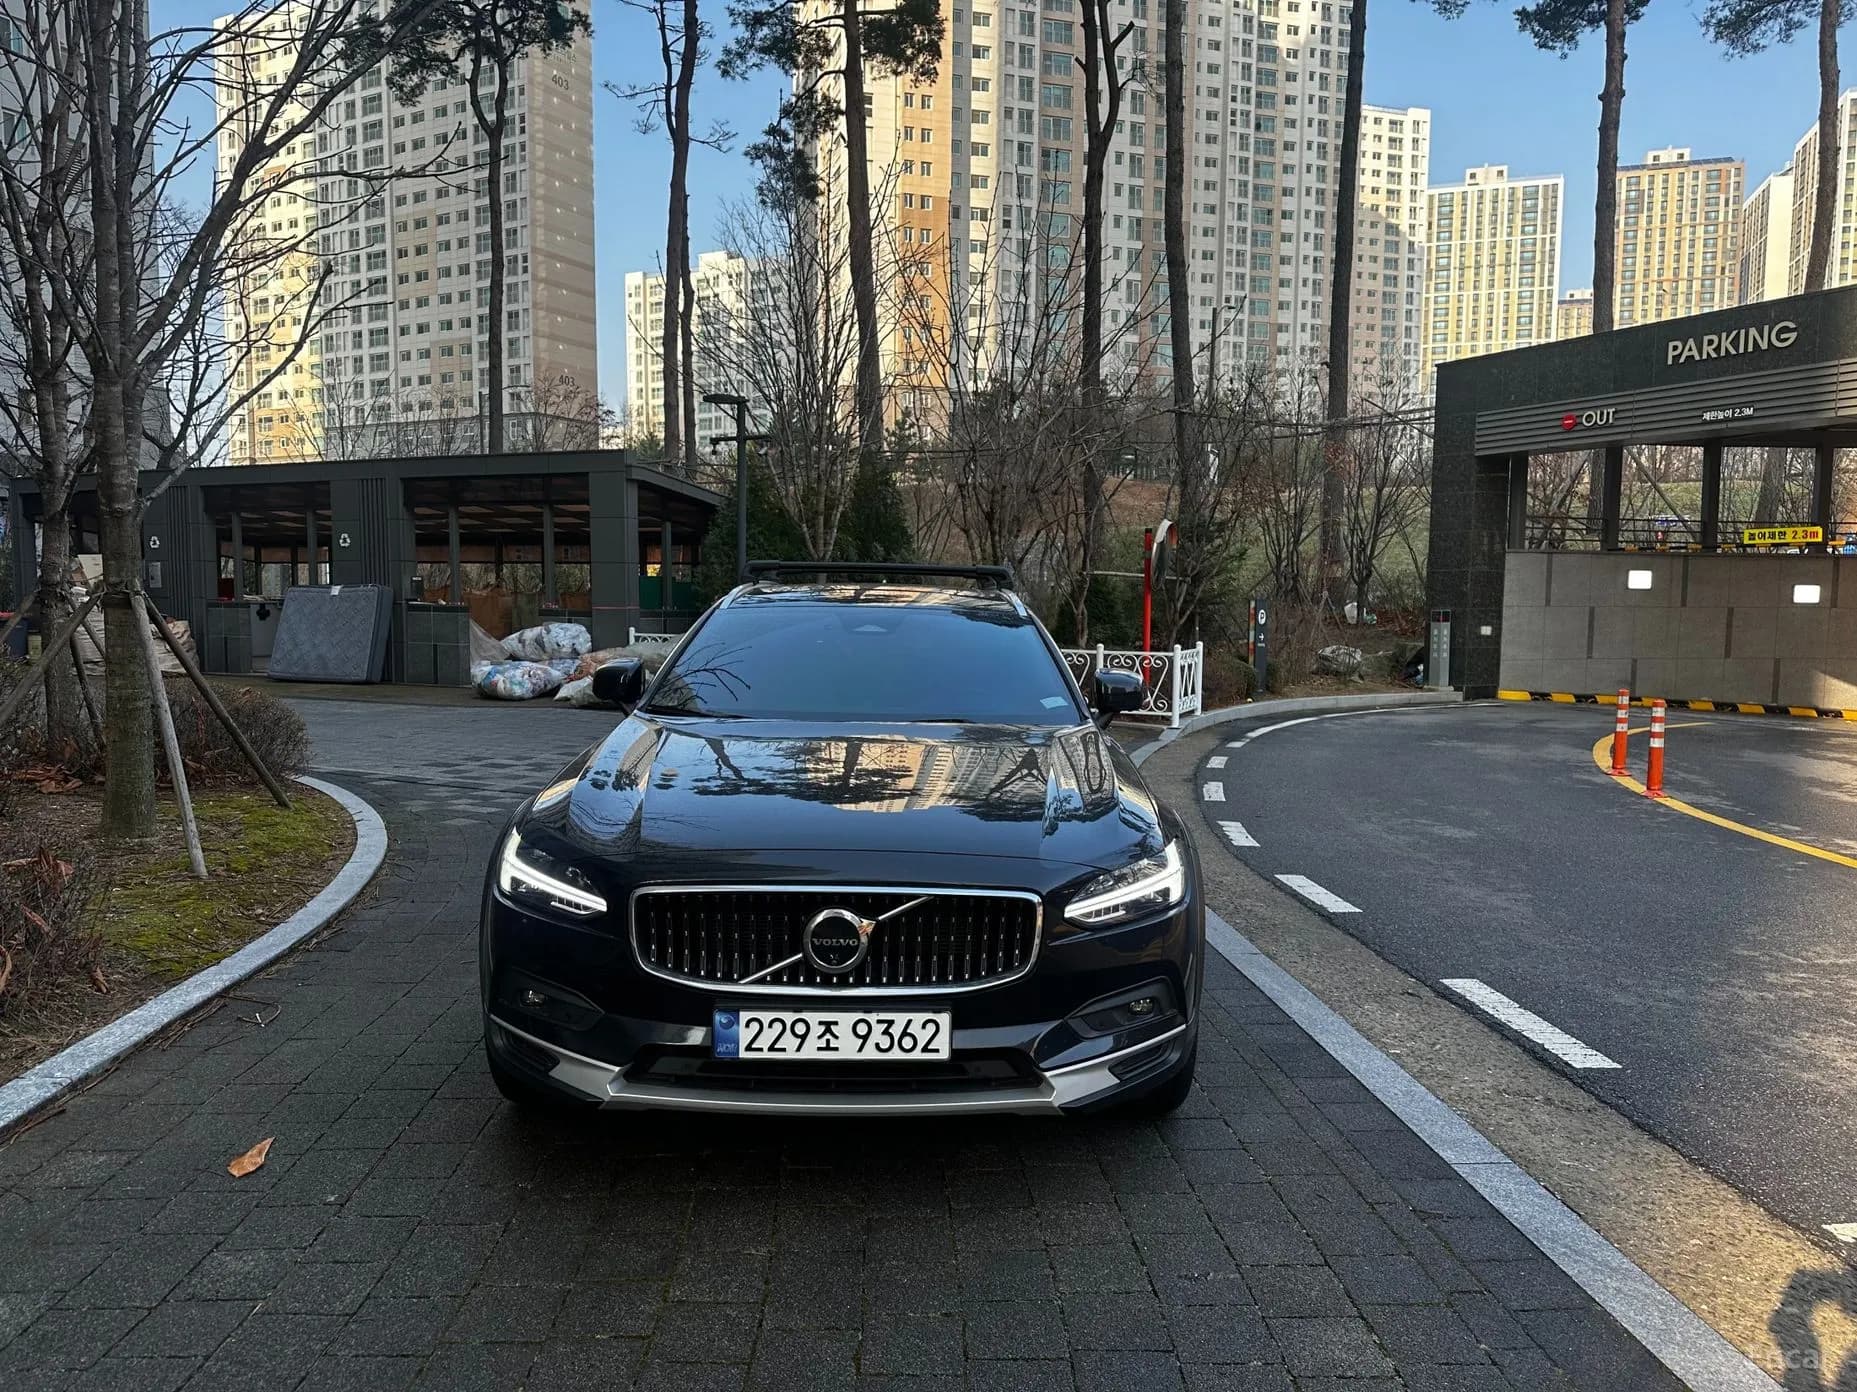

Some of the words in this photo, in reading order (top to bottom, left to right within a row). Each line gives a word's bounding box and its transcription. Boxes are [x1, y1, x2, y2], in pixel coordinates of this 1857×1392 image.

[552, 74, 569, 90] 403
[1666, 320, 1798, 366] PARKING
[559, 375, 575, 387] 403
[1582, 407, 1616, 427] OUT
[1702, 408, 1733, 421] 제한높이
[1734, 407, 1754, 417] 2.3M
[1748, 530, 1787, 541] 높이제한
[1791, 529, 1819, 540] 2.3m
[811, 937, 858, 946] VOLVO
[744, 1017, 840, 1053] 229조
[851, 1018, 941, 1053] 9362
